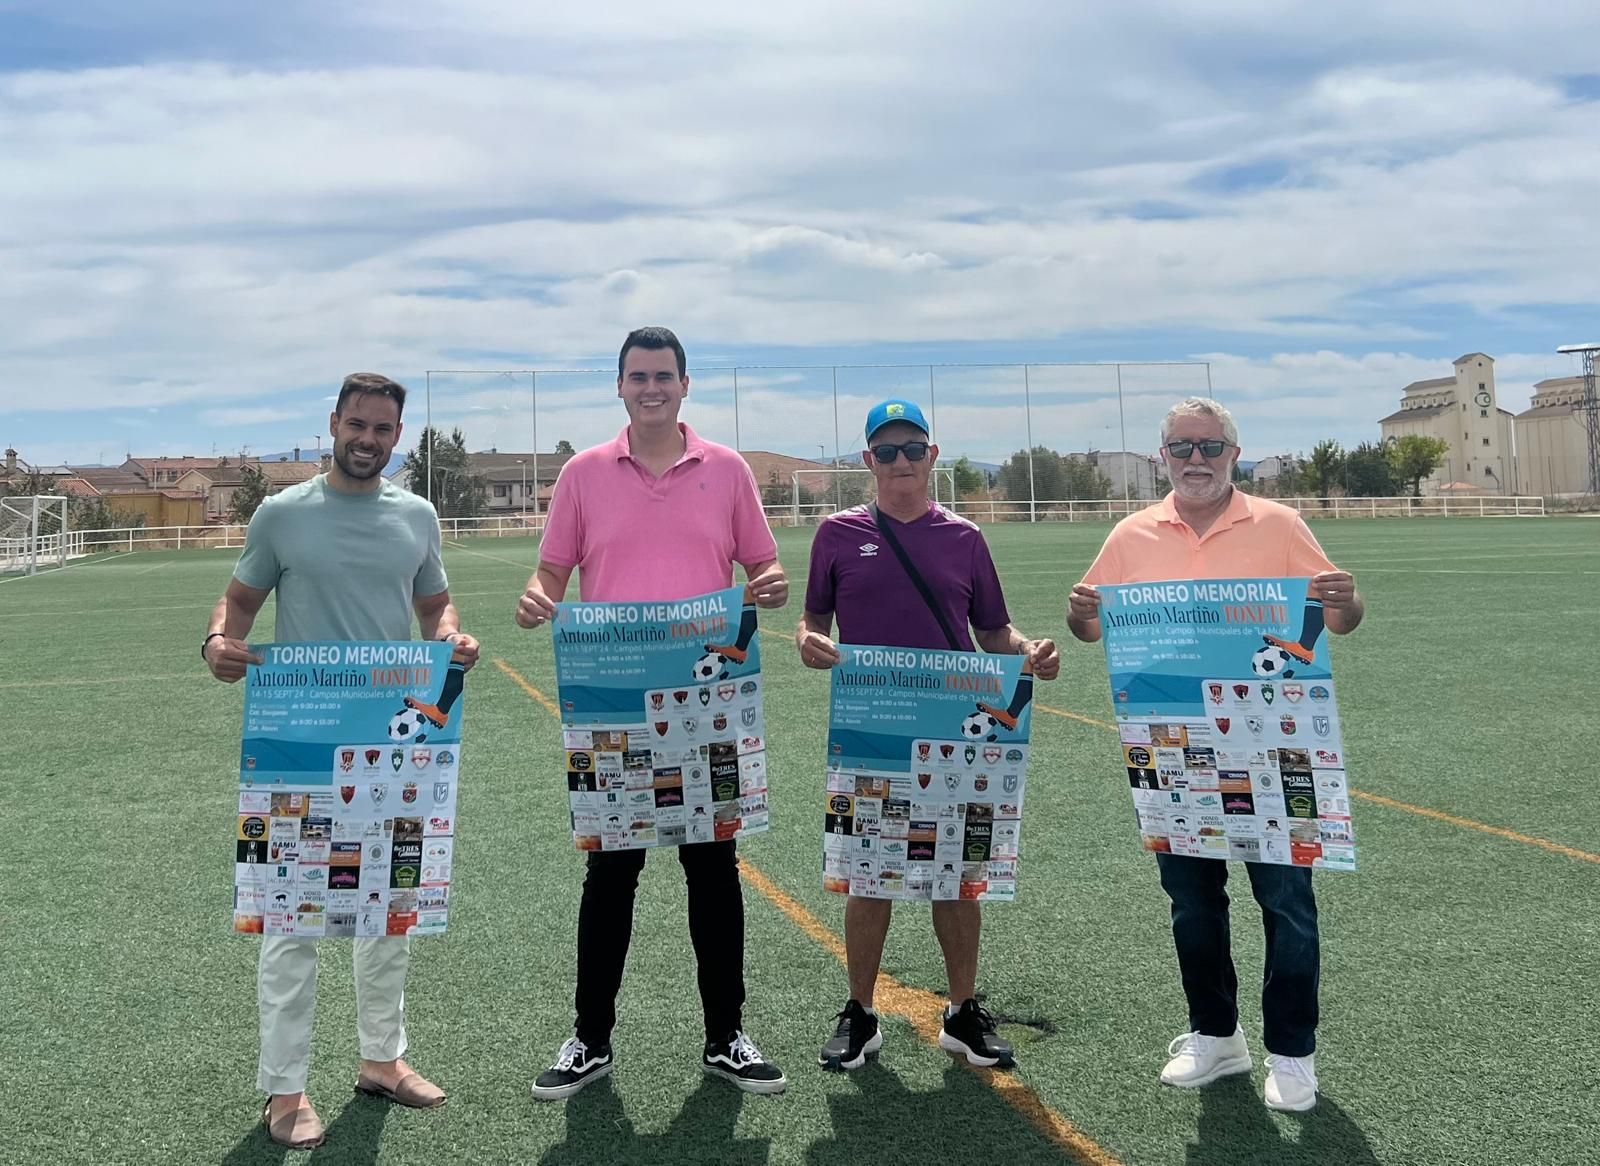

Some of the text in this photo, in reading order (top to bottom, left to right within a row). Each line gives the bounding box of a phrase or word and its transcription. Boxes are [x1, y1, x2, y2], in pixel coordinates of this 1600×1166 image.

[1118, 585, 1189, 606] TORNEO
[1193, 583, 1288, 602] MEMORIAL
[572, 606, 638, 625] TORNEO
[642, 596, 728, 623] MEMORIAL
[1106, 608, 1161, 628] Antonio
[1163, 606, 1220, 624] Martiño
[559, 627, 611, 644] Antonio
[613, 626, 666, 643] Martiño
[271, 646, 341, 665] TORNEO
[344, 646, 433, 665] MEMORIAL
[853, 649, 917, 669] TORNEO
[920, 653, 1005, 675] MEMORIAL
[251, 667, 308, 687] Antonio
[311, 667, 367, 687] Martiño
[836, 669, 887, 686] Antonio
[889, 670, 941, 689] Martiño
[888, 689, 916, 698] Campos
